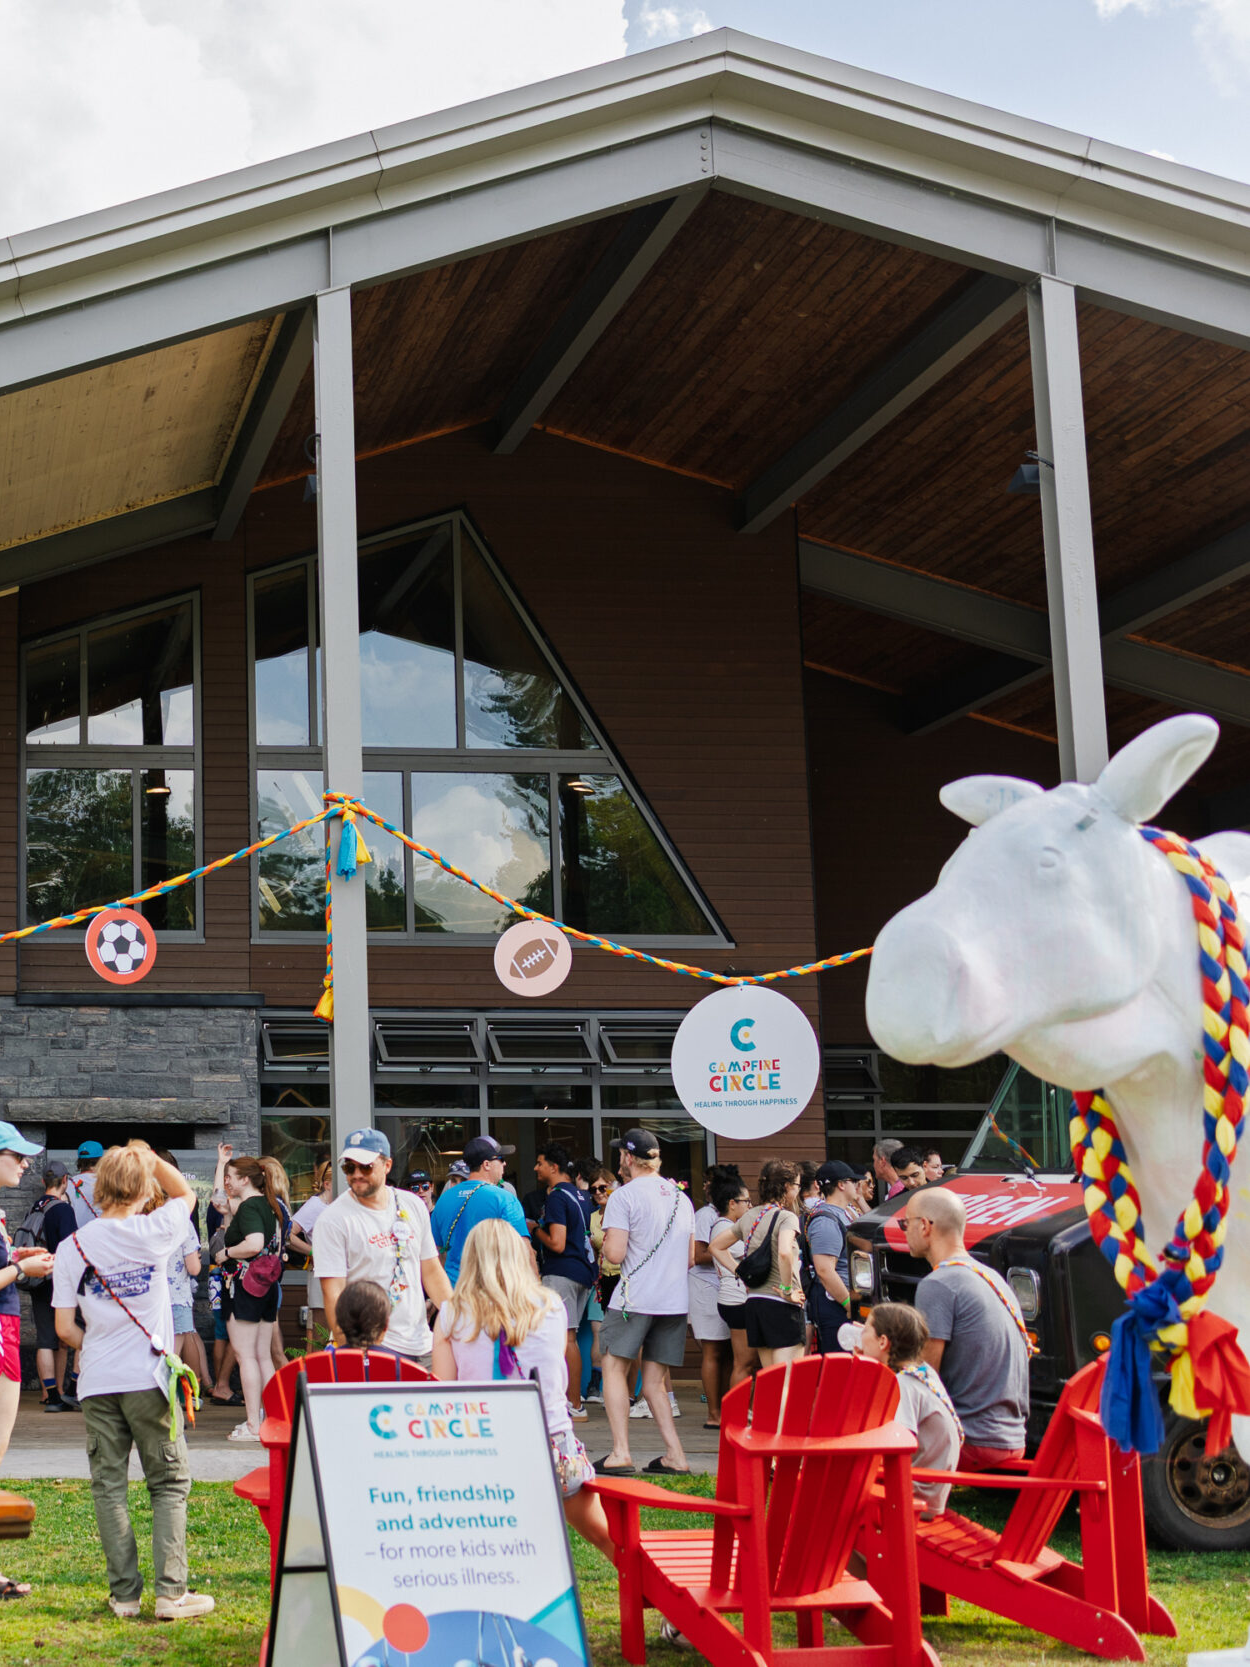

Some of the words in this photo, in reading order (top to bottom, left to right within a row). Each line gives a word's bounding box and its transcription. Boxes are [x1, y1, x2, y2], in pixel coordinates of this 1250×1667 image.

[708, 1059, 781, 1073] CAMPFIRE
[709, 1073, 781, 1092] CIRCLE
[724, 1099, 758, 1107] THROUGH
[759, 1097, 798, 1106] HAPPINESS
[404, 1402, 490, 1416] CAMPFIRE
[408, 1418, 494, 1439] CIRCLE
[374, 1450, 409, 1459] HEALING
[412, 1449, 451, 1458] THROUGH
[453, 1448, 498, 1457] HAPPINESS
[369, 1487, 412, 1506] Fun,
[416, 1483, 515, 1504] friendship
[376, 1513, 414, 1531] and
[419, 1512, 518, 1530] adventure
[380, 1542, 404, 1560] for
[410, 1544, 457, 1559] more
[460, 1539, 497, 1557] kids
[499, 1538, 537, 1556] with
[393, 1569, 458, 1588] serious
[462, 1567, 520, 1585] illness.
